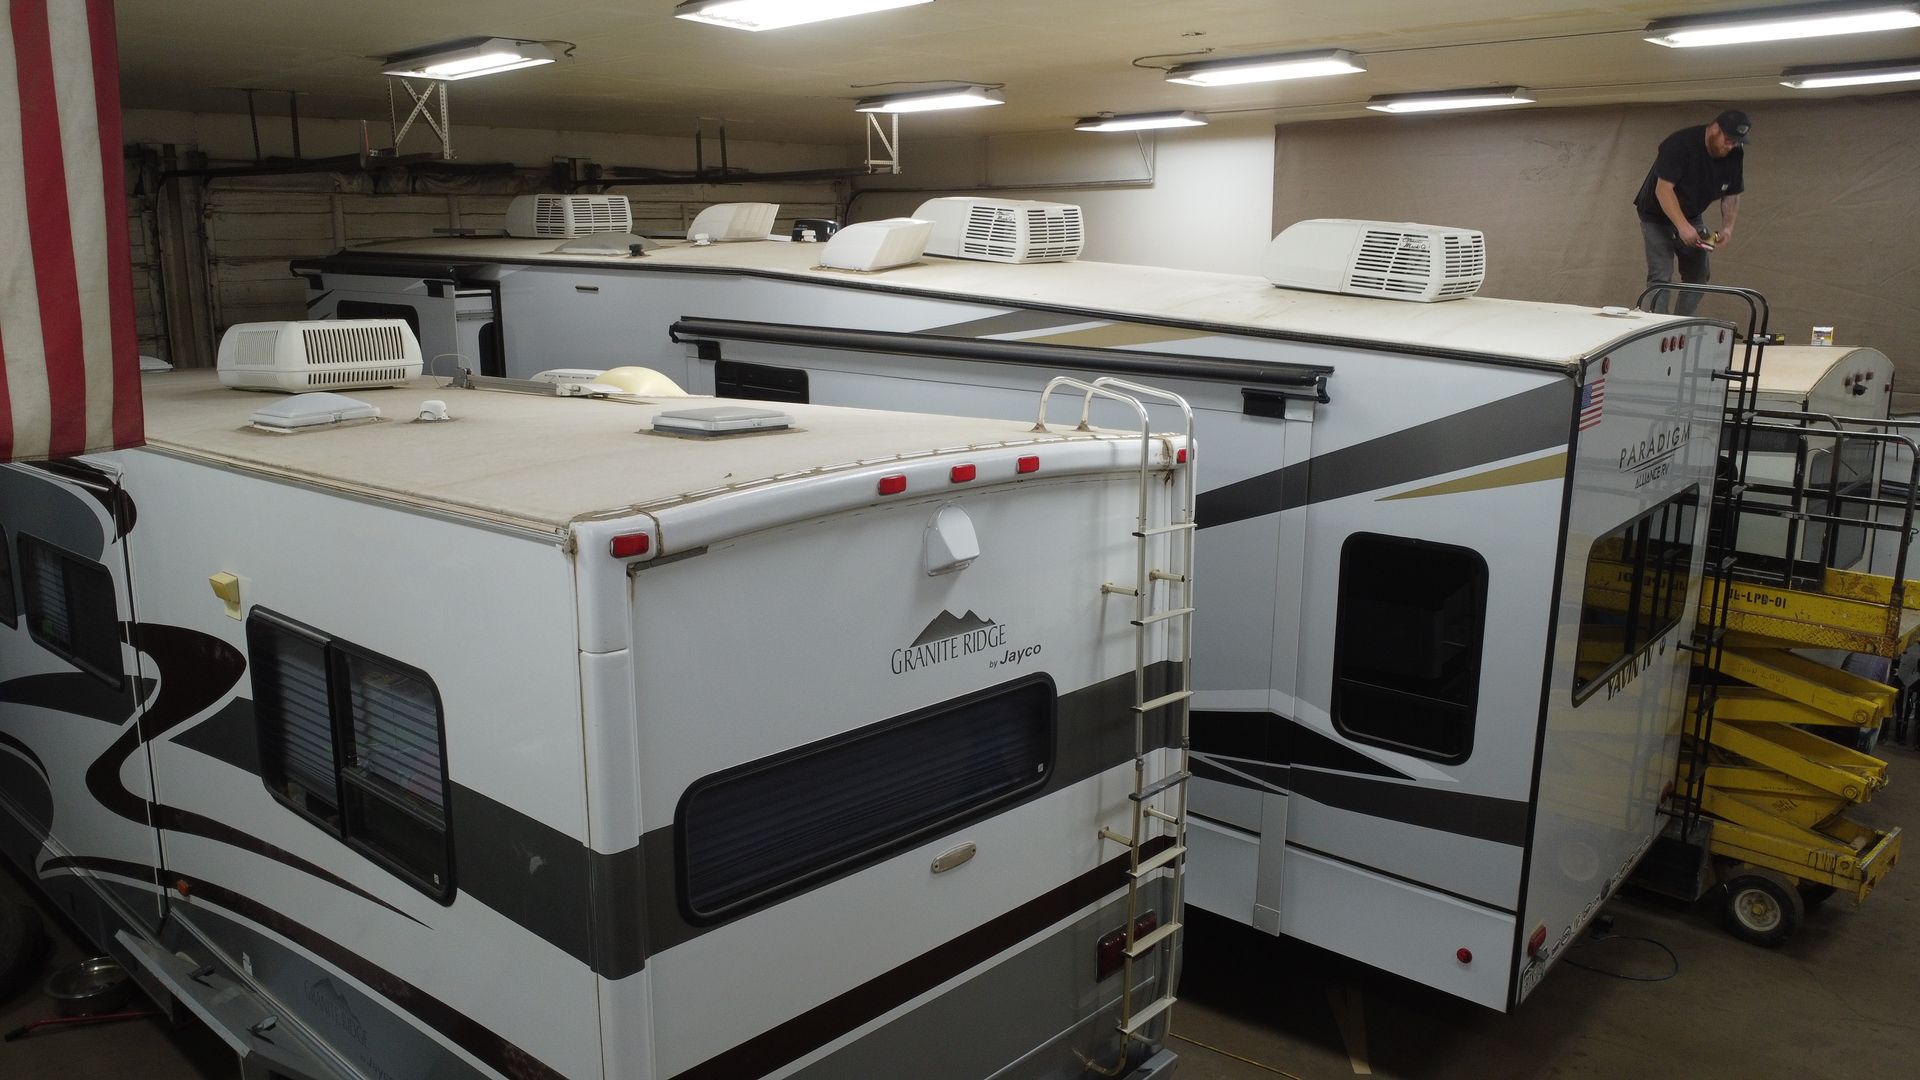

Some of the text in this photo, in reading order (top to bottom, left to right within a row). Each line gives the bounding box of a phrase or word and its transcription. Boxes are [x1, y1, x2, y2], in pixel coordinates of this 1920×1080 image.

[1619, 421, 1691, 470] PARADIGM
[1634, 466, 1661, 489] ALLIANCE
[891, 624, 1006, 675] GRANITE RIDGE
[989, 644, 1042, 669] by Jayco
[1607, 655, 1640, 701] YAVIN
